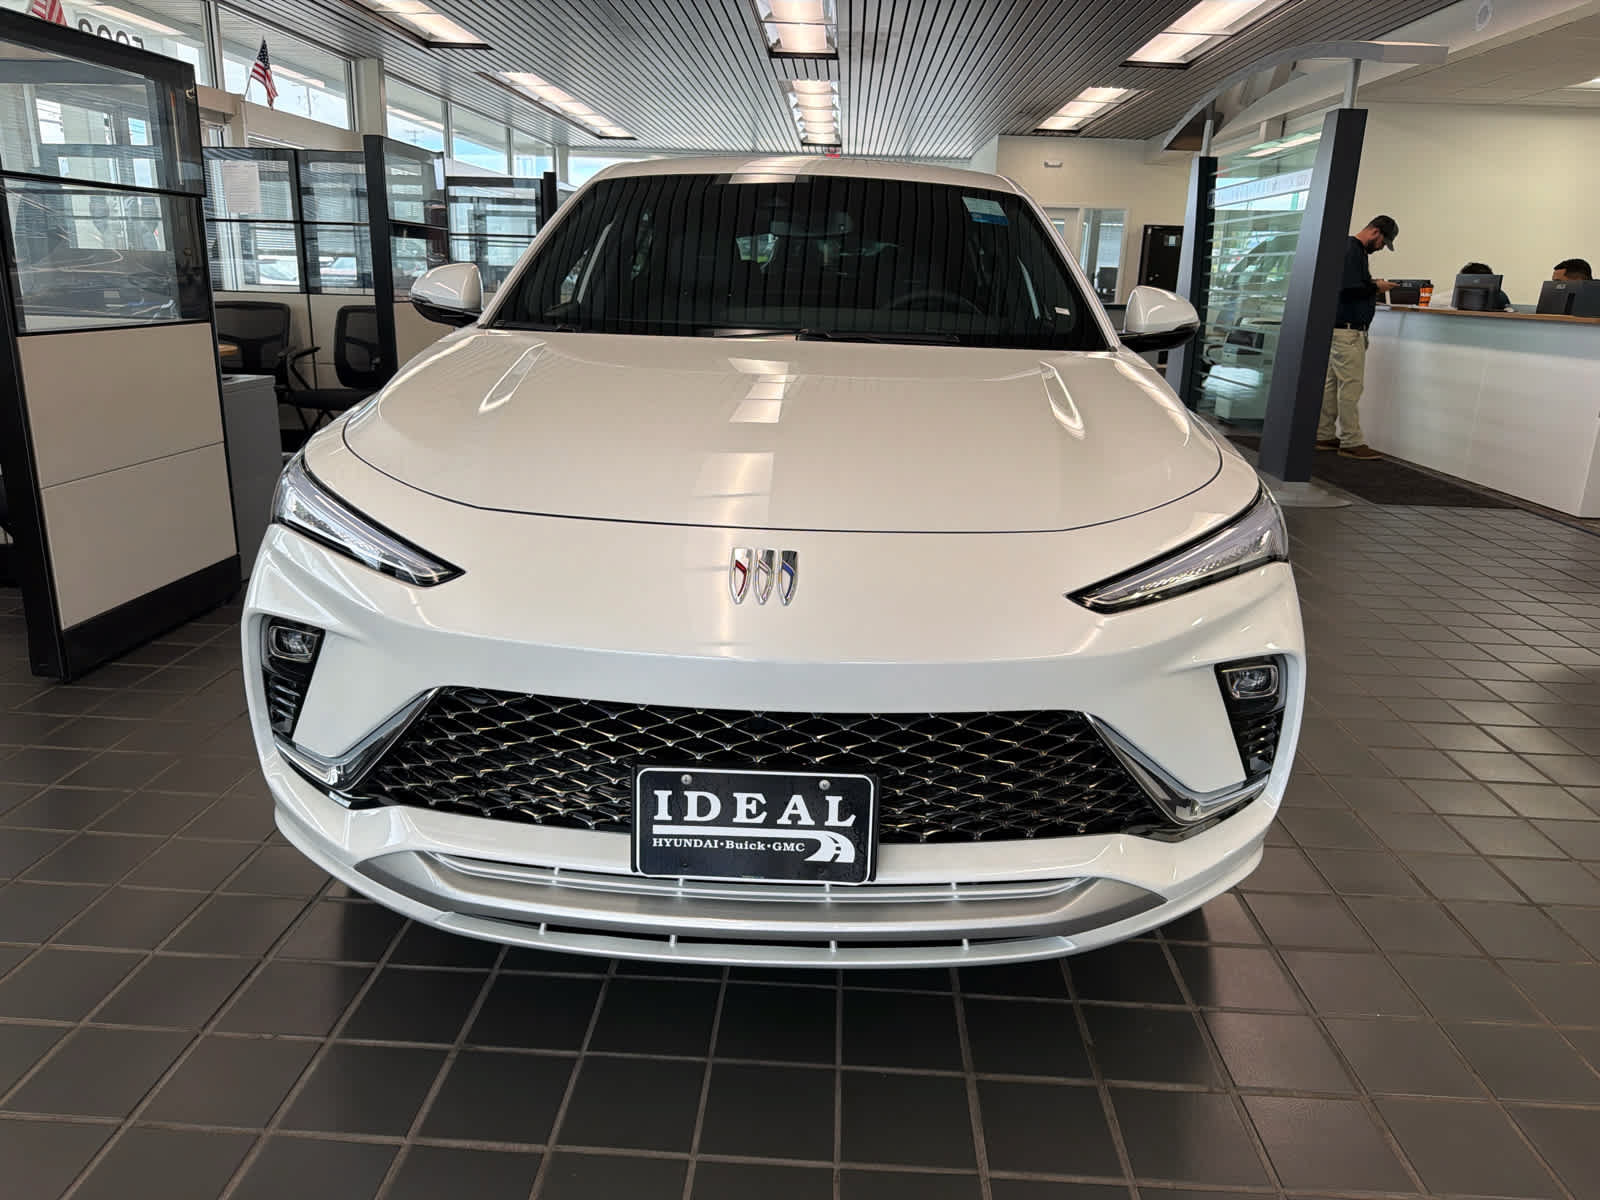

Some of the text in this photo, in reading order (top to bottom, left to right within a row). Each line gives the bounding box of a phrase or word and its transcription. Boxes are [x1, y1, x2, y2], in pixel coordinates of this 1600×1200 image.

[653, 789, 857, 828] IDEAL
[652, 837, 806, 853] HYUNDAI Buick GMC
